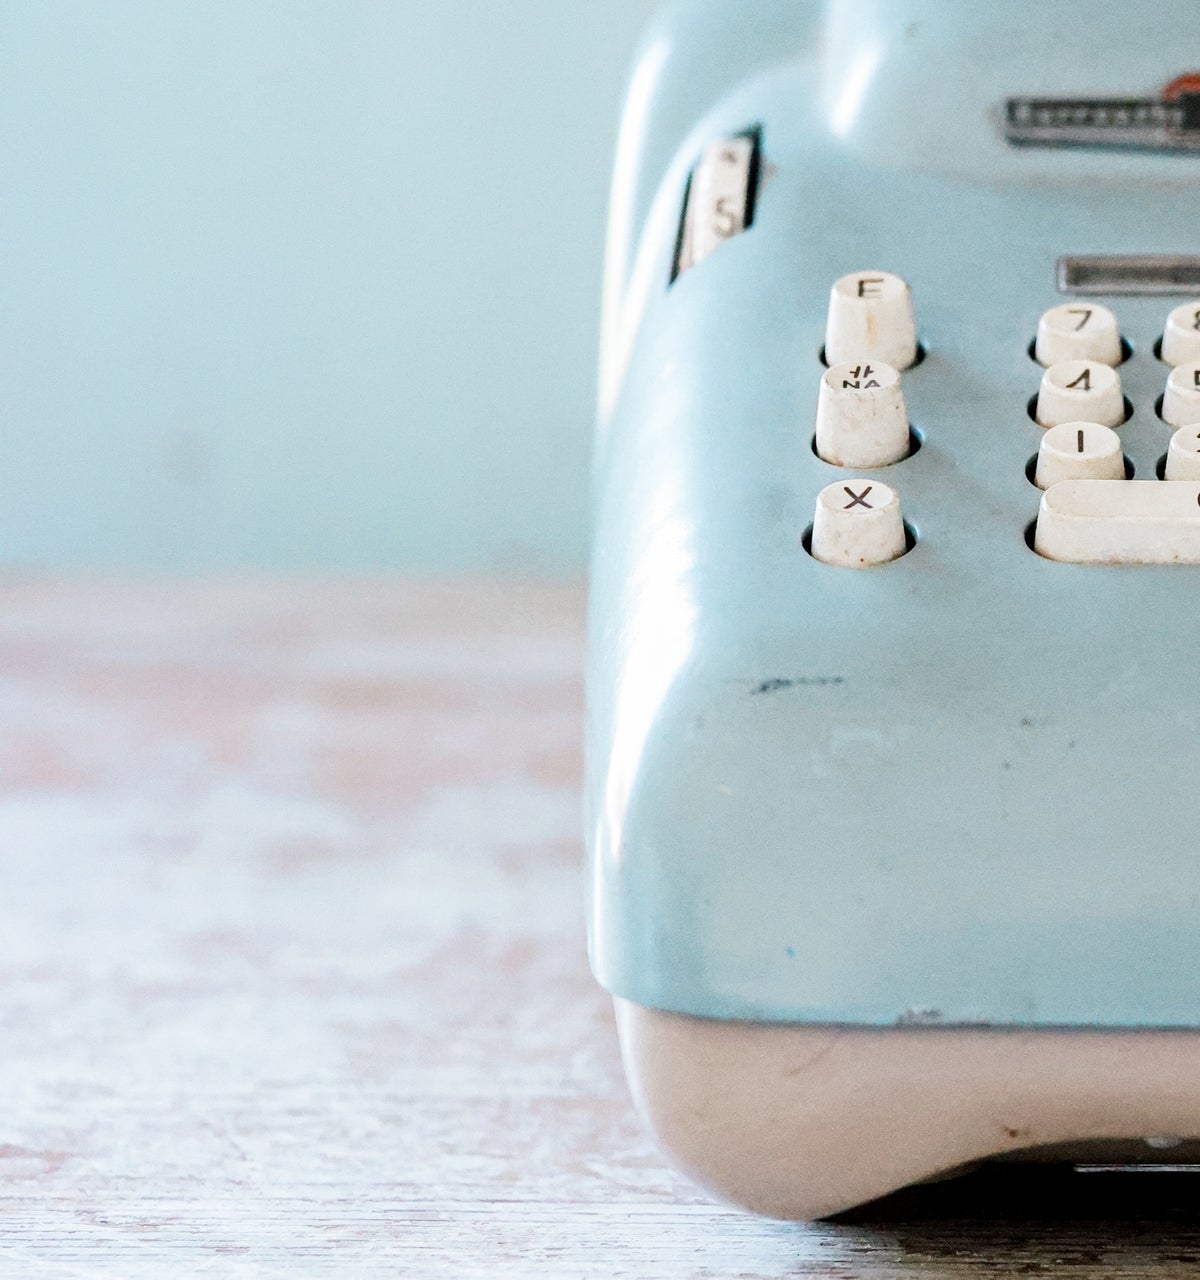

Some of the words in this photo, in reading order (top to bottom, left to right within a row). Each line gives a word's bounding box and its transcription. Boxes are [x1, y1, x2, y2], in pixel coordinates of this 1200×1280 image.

[1068, 310, 1093, 332] 7
[1065, 368, 1092, 393] 4
[1077, 429, 1085, 454] 1
[843, 486, 874, 509] X
